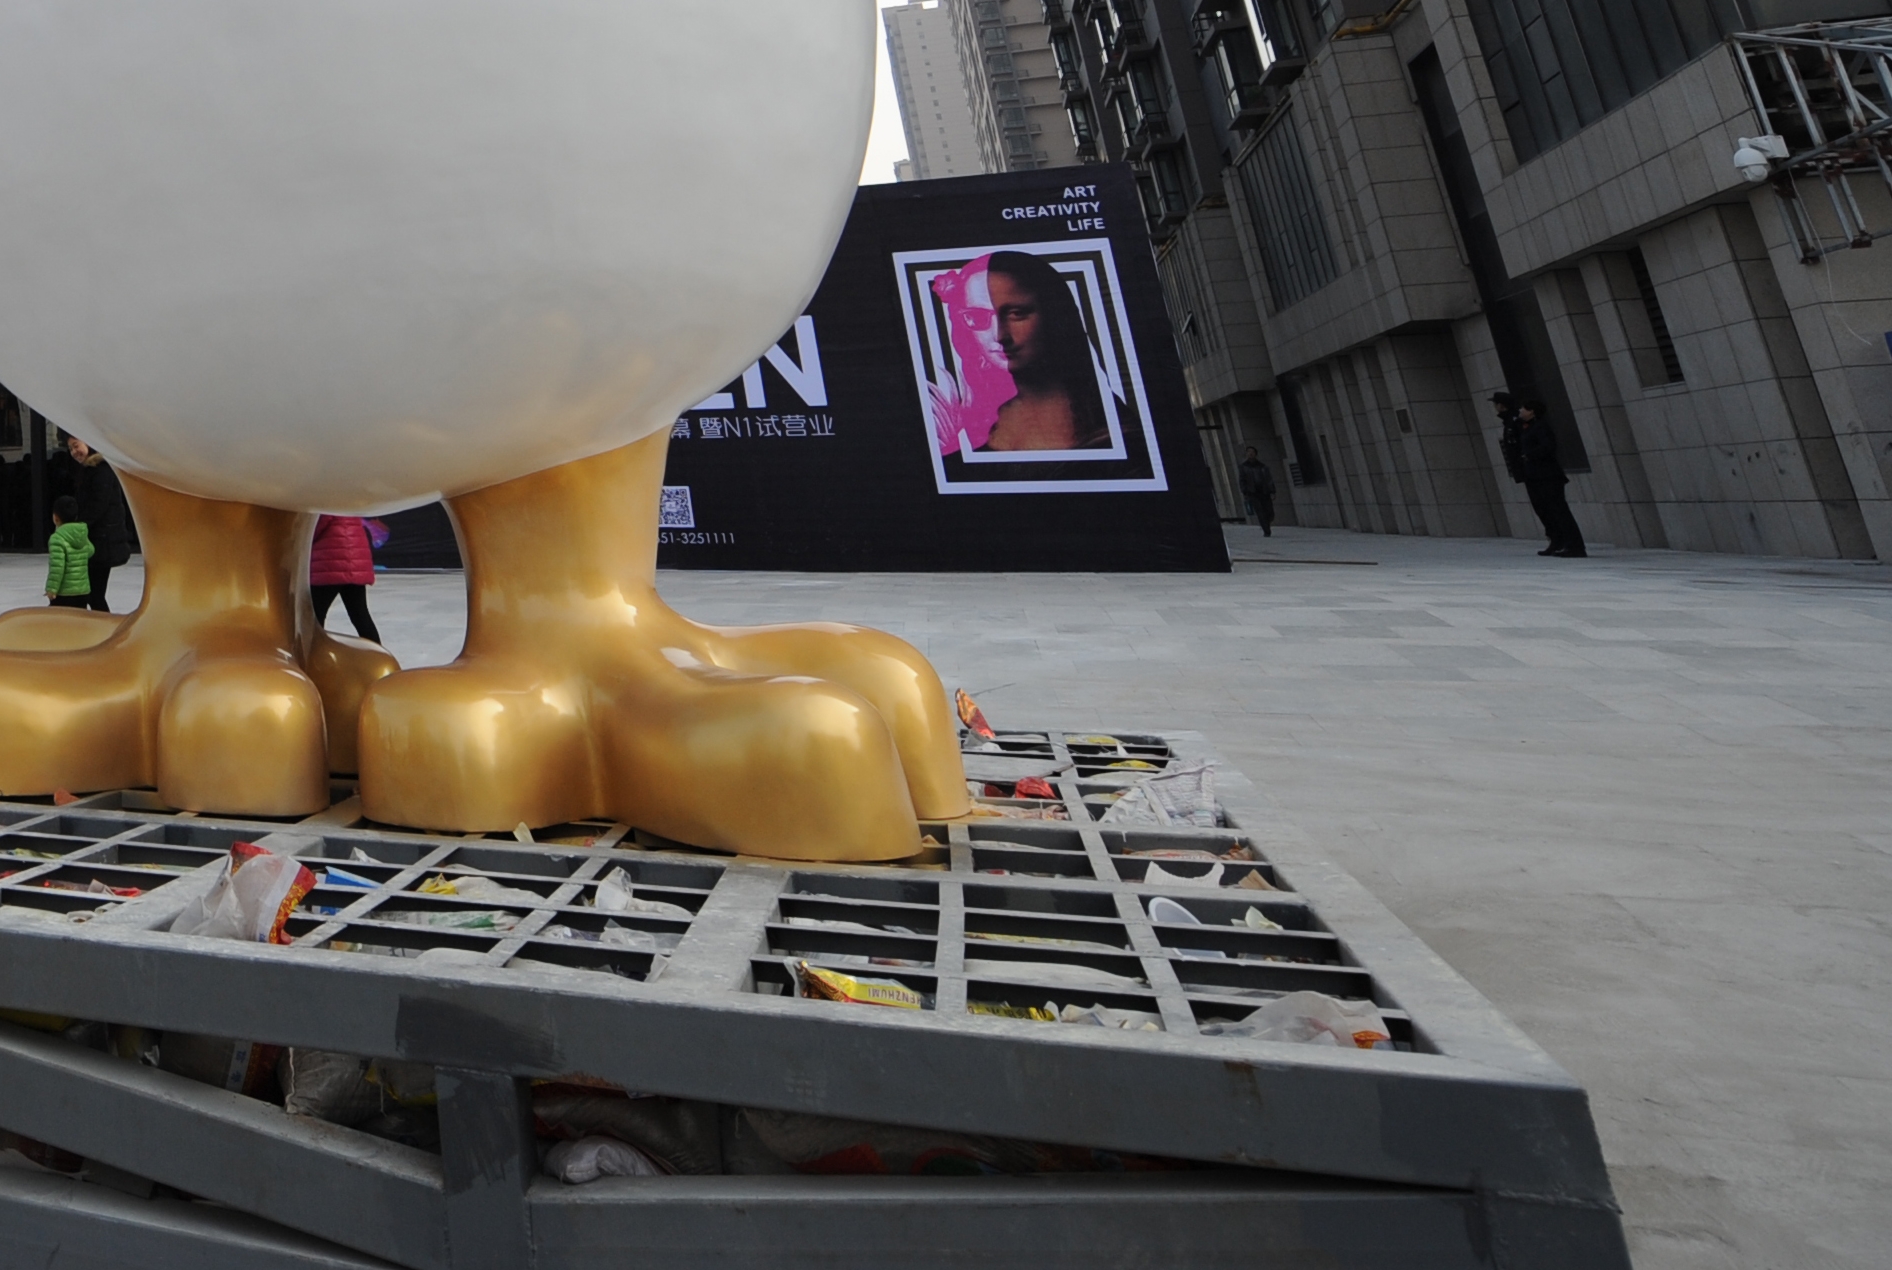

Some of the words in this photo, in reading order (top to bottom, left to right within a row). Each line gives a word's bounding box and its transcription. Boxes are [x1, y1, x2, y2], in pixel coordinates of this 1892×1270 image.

[1063, 185, 1096, 199] ART
[1001, 201, 1100, 220] CREATIVITY
[1067, 218, 1106, 232] LIFE
[700, 414, 836, 439] 暨N1试营业
[657, 532, 735, 545] 51-3251111
